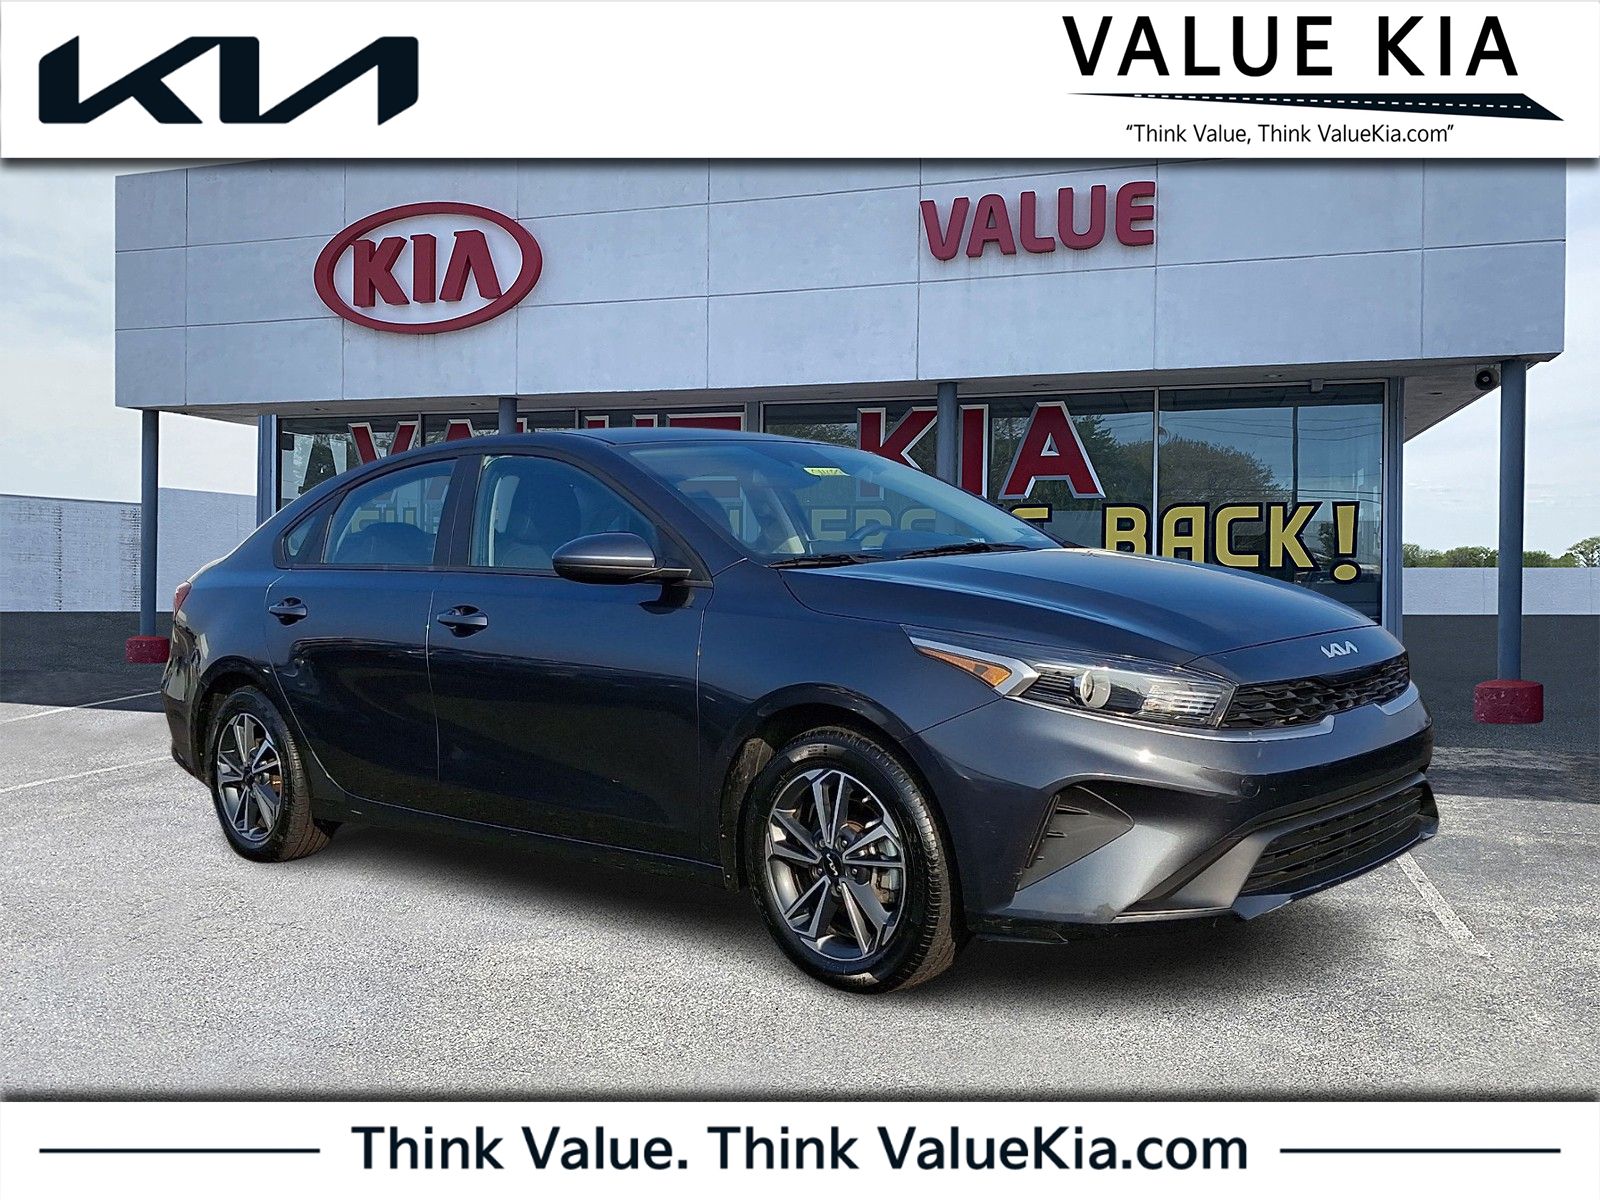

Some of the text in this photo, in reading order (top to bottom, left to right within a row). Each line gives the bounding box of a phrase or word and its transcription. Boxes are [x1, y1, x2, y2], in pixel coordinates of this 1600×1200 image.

[920, 181, 1156, 261] VALUE
[352, 230, 502, 308] KIA
[858, 400, 1106, 500] KIA
[1102, 501, 1361, 584] BACK!
